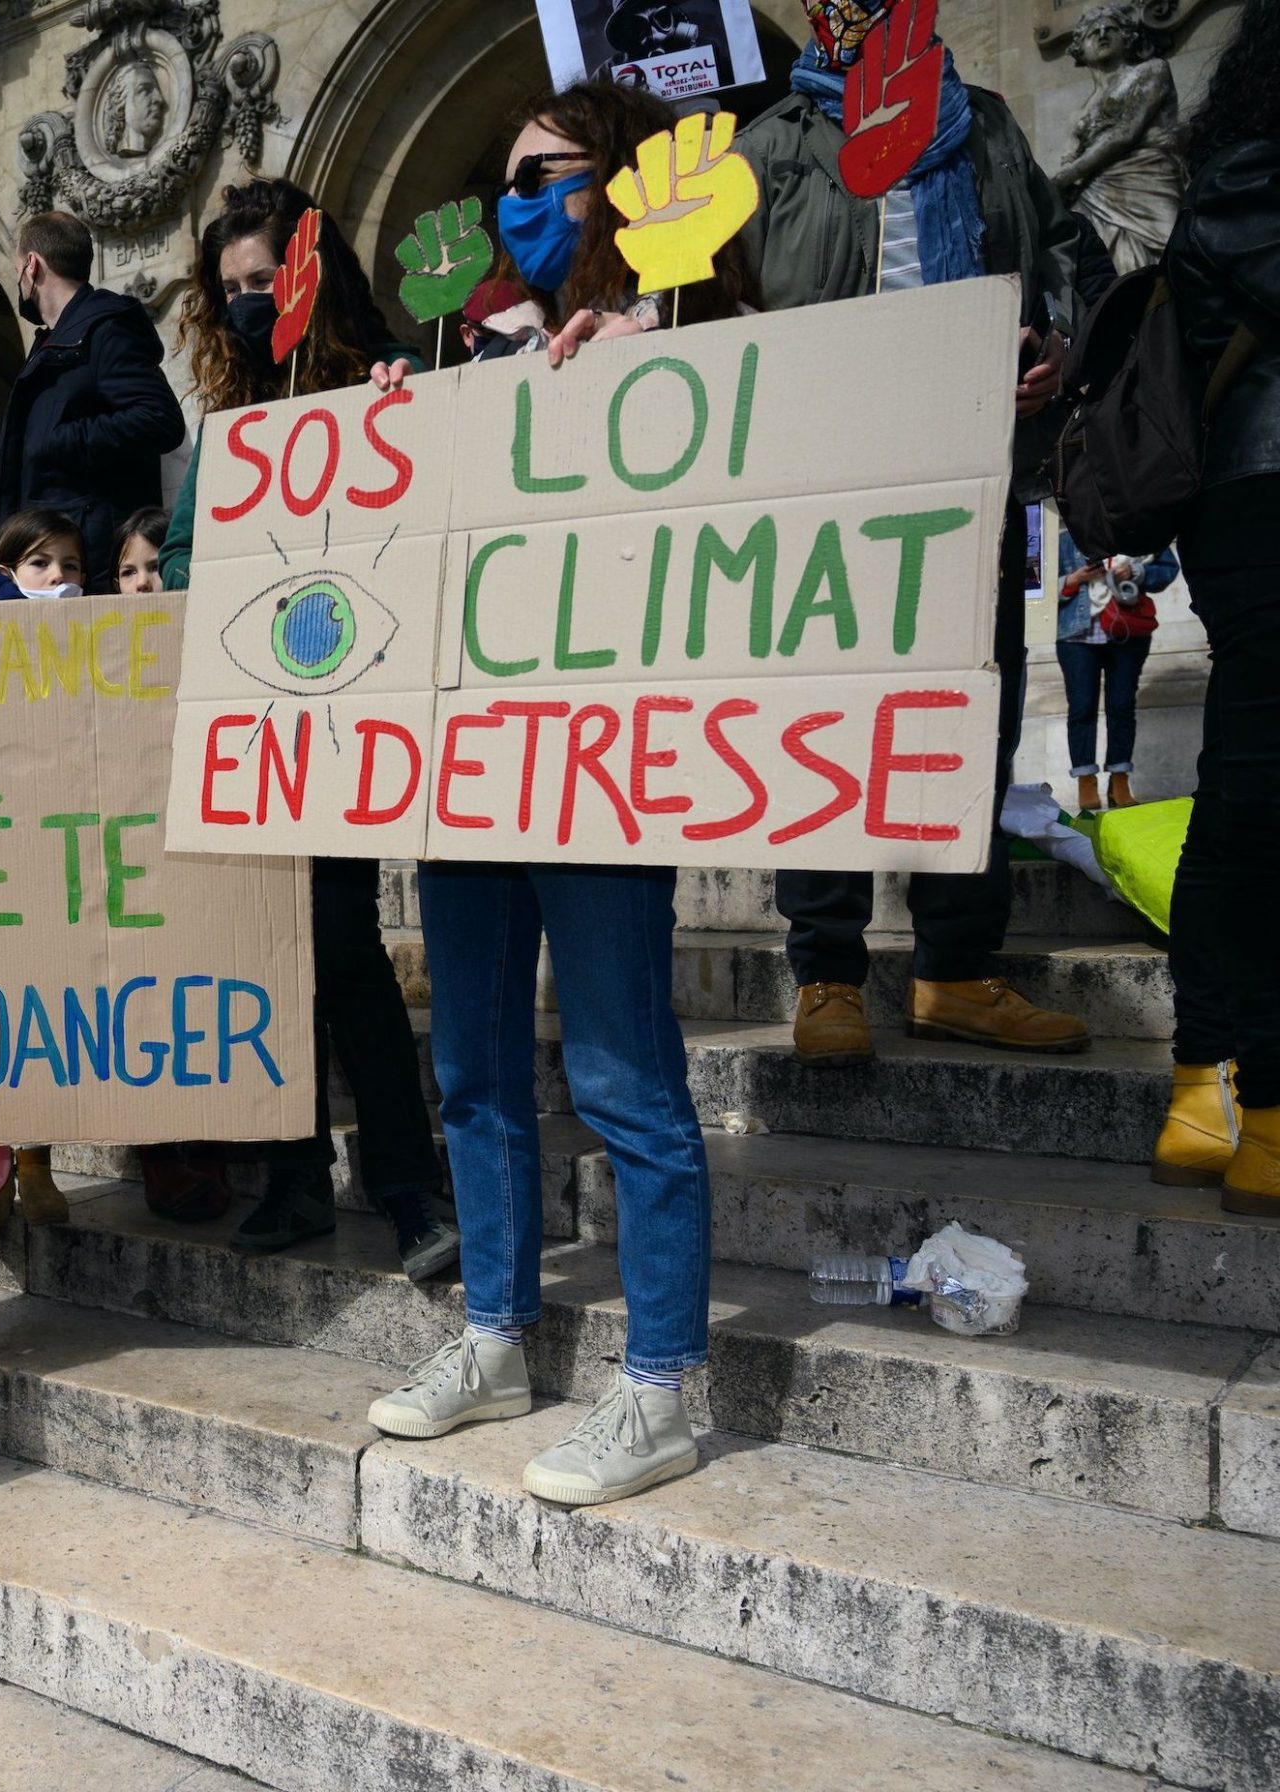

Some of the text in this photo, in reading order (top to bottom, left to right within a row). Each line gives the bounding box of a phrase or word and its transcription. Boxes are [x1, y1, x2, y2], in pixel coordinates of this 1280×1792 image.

[652, 59, 715, 79] TOTAL
[665, 74, 707, 86] RENDEZ-VOUS
[674, 80, 714, 93] TRIBUNAL
[116, 227, 170, 267] BACH
[212, 342, 759, 521] SOS LOI
[463, 506, 975, 678] CLIMAT
[202, 689, 971, 846] EN DETRESSE
